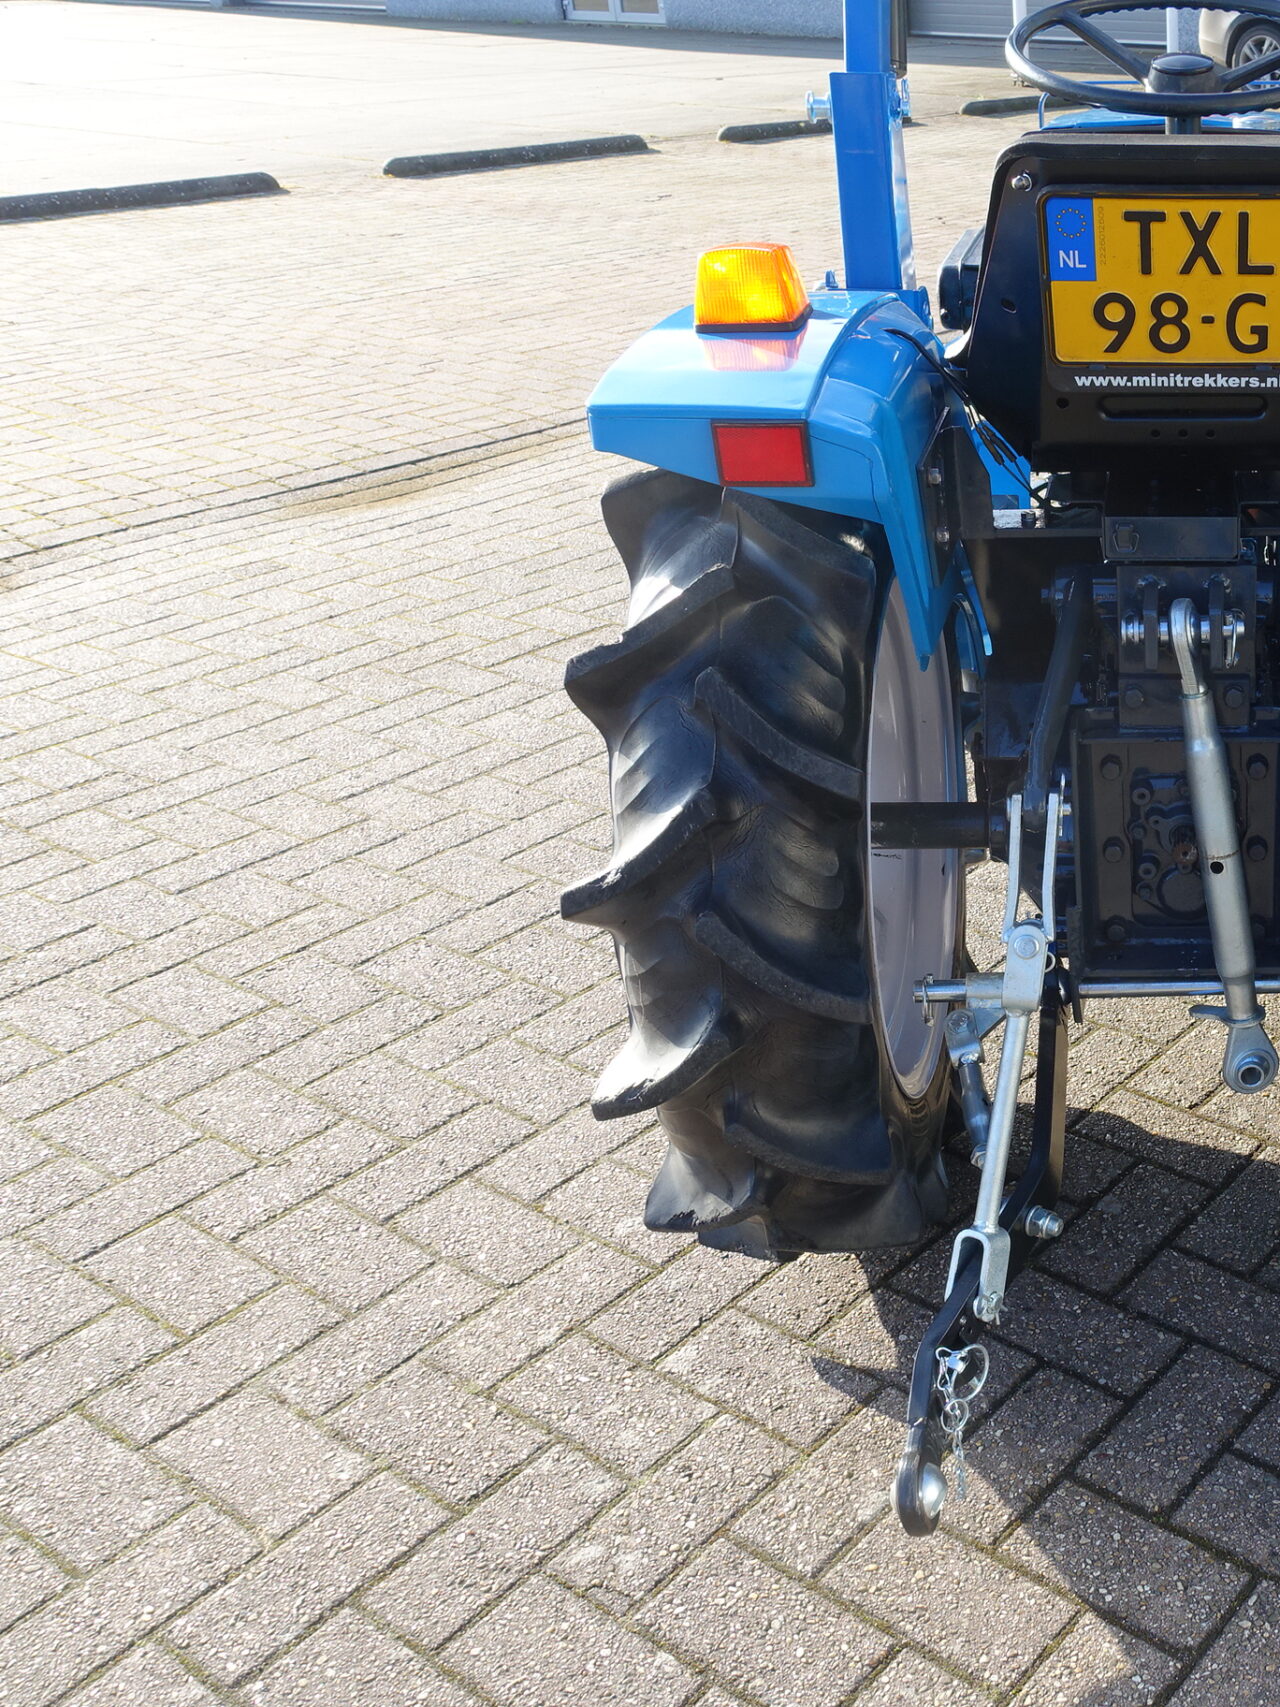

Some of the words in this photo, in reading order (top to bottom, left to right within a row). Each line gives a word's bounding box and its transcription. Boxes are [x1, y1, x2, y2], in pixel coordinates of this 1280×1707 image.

[1058, 250, 1087, 269] NL
[1123, 210, 1275, 275] TXL
[1092, 292, 1269, 354] 98-G
